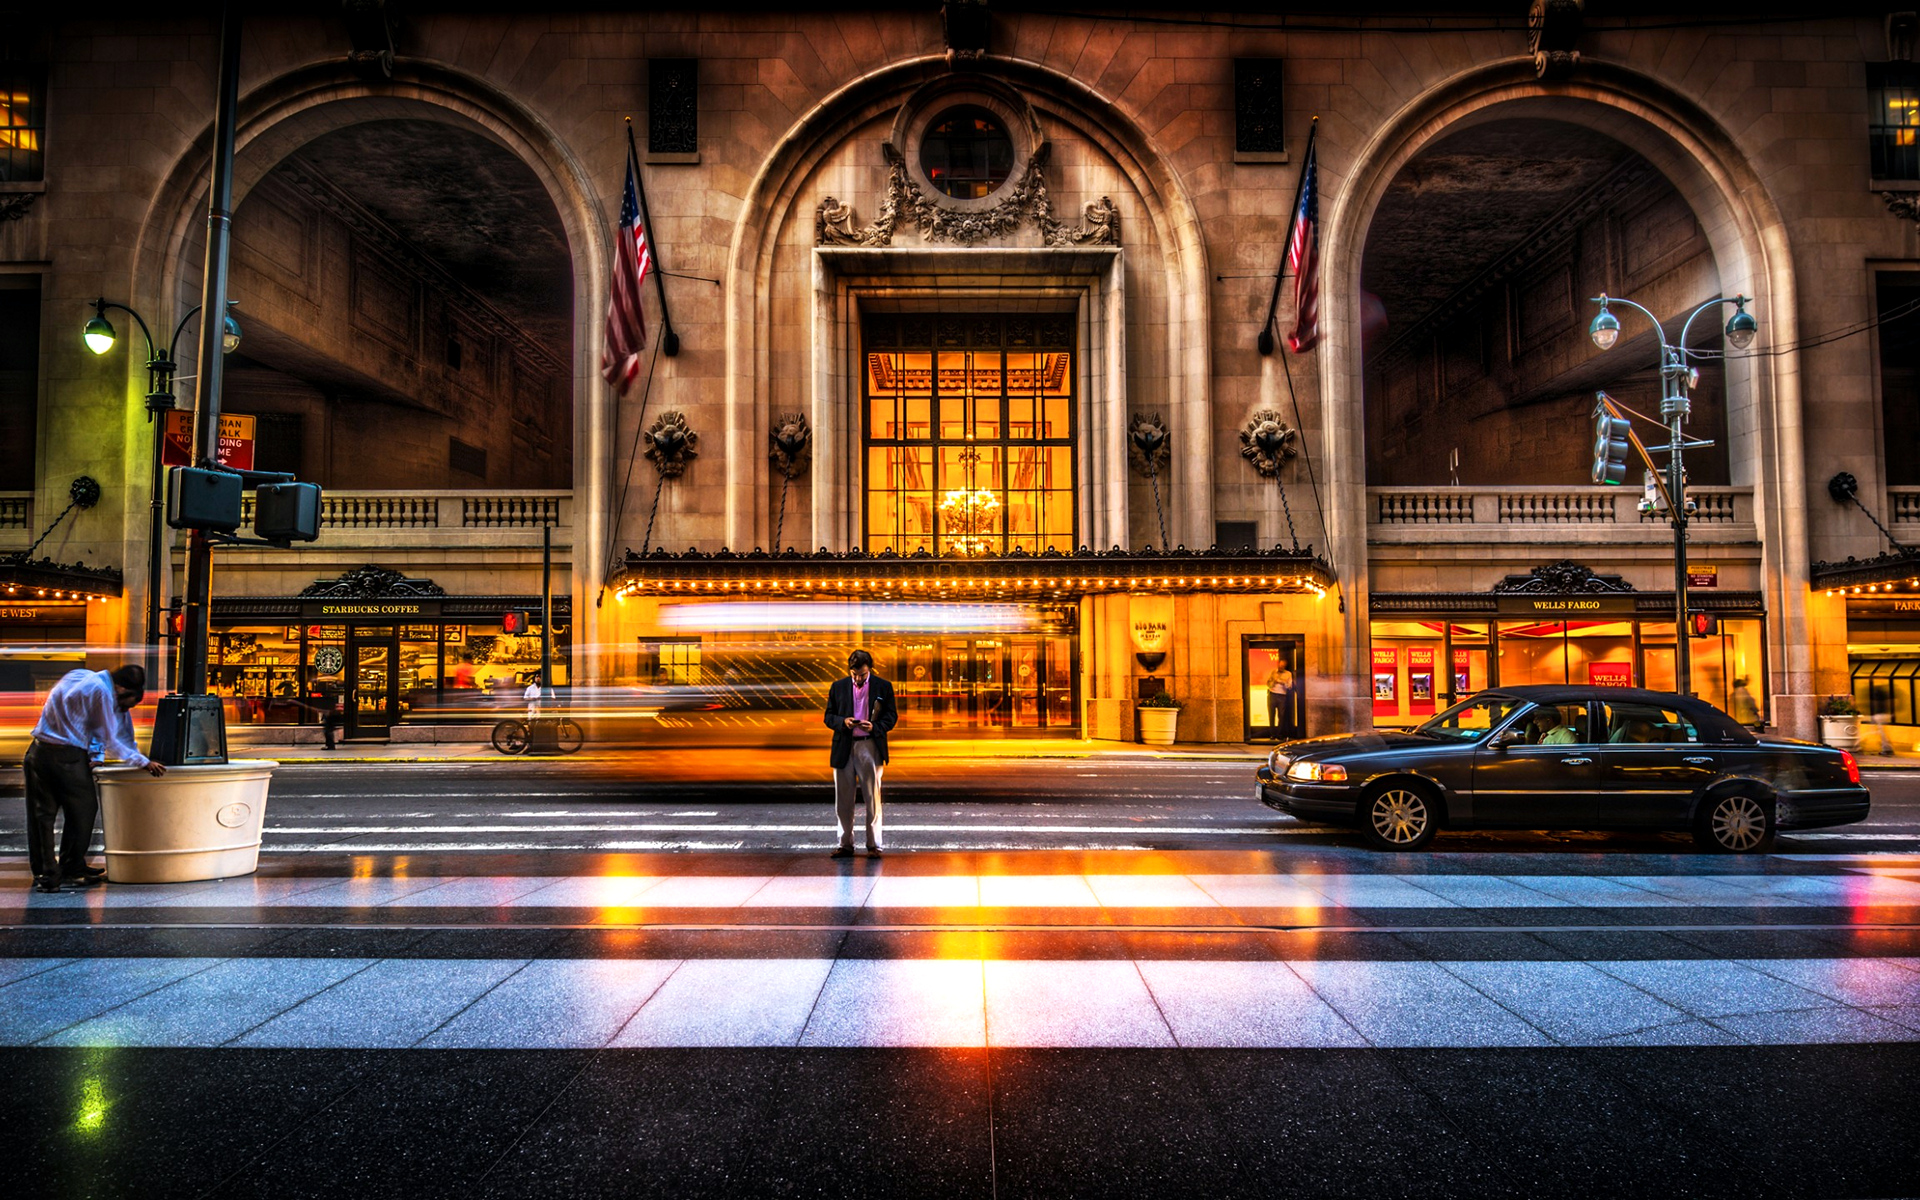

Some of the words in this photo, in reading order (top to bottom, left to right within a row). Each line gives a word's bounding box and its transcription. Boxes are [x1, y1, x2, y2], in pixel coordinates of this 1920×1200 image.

[180, 415, 242, 428] PERIAN
[180, 425, 241, 437] CRALK
[322, 605, 379, 613] STARBUCKS
[381, 605, 419, 613] COFFEE
[1533, 601, 1566, 609] WELLS
[1567, 601, 1600, 609] FARGO
[10, 609, 37, 618] WEST
